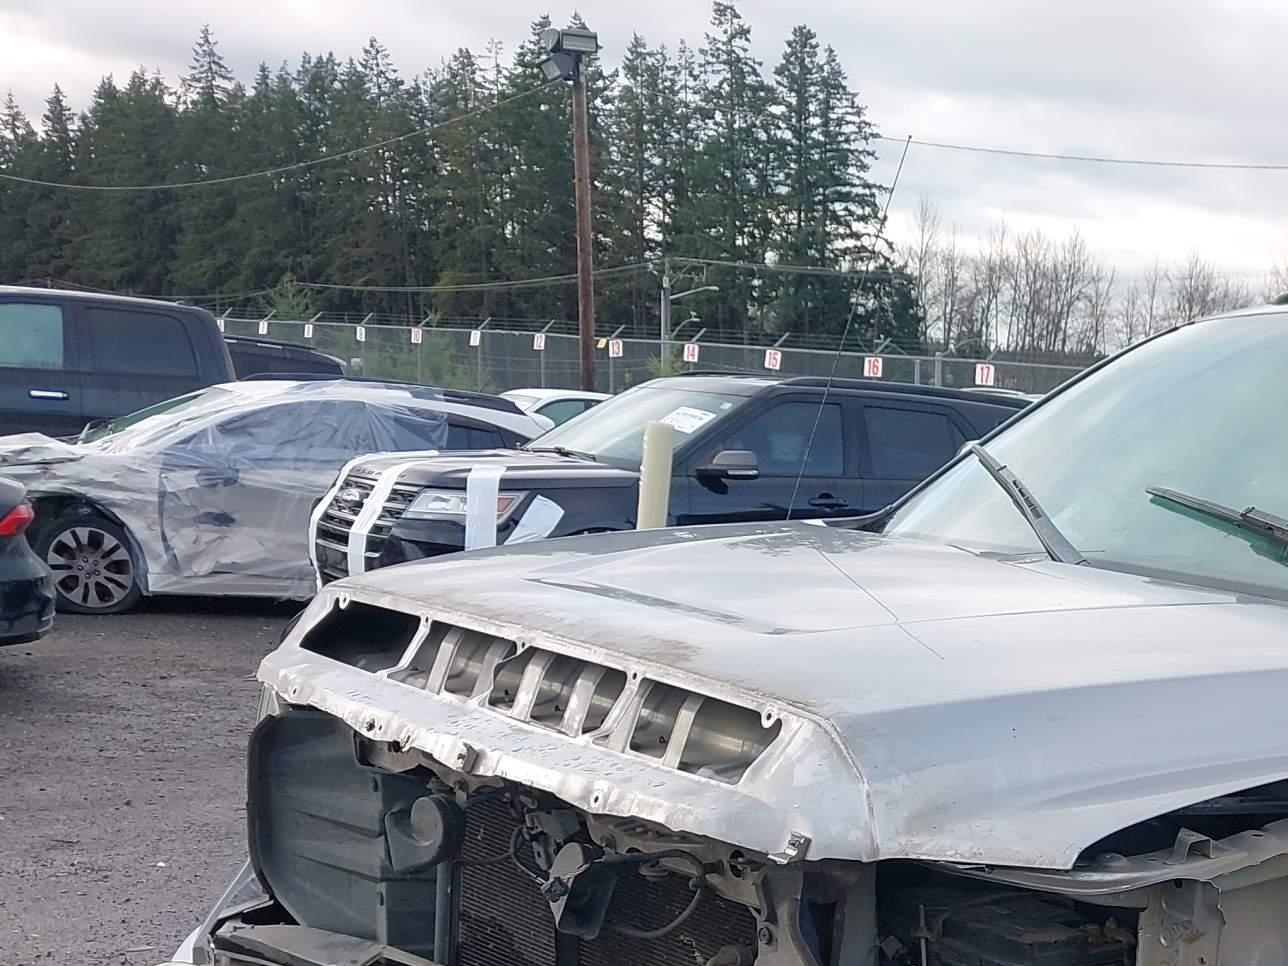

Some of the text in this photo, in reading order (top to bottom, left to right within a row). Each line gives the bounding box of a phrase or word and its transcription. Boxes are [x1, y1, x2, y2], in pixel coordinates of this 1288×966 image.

[610, 340, 621, 356] 13
[686, 344, 696, 361] 14
[767, 351, 779, 368] 15
[867, 358, 880, 375] 16
[978, 364, 991, 383] 17
